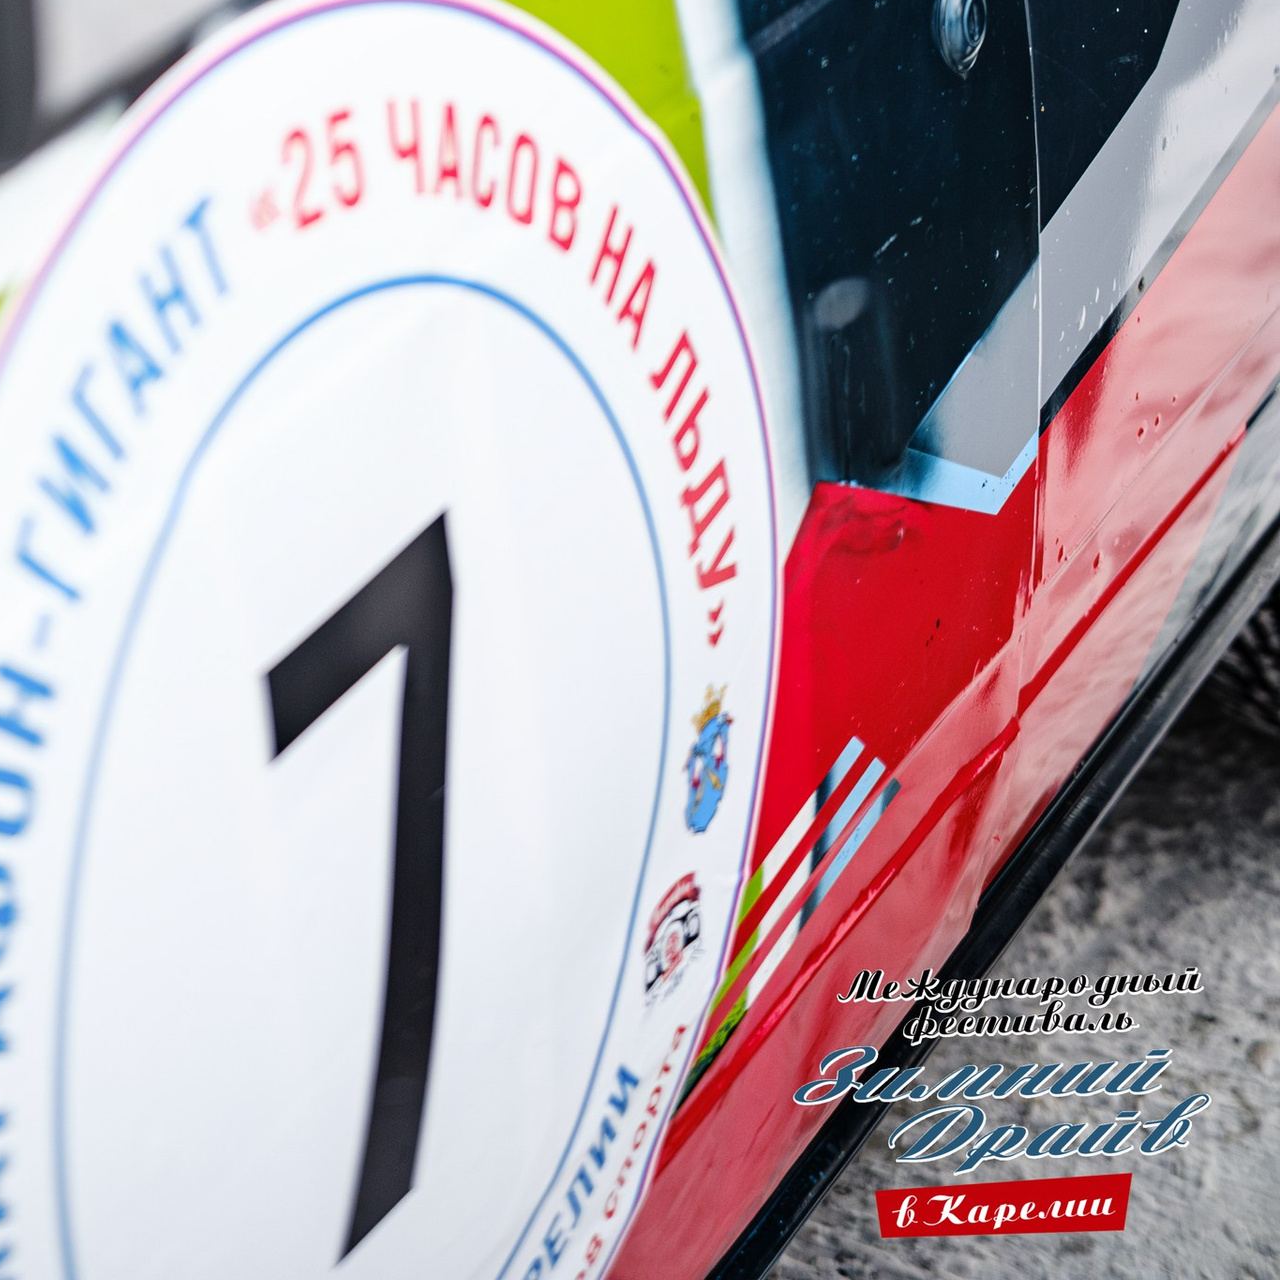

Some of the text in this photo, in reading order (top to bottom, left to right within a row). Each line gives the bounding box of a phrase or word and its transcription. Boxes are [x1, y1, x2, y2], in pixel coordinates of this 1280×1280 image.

[385, 97, 586, 253] ЧАСОВ
[587, 202, 657, 352] НА
[263, 506, 455, 1268] 7
[603, 1024, 687, 1221] спорта
